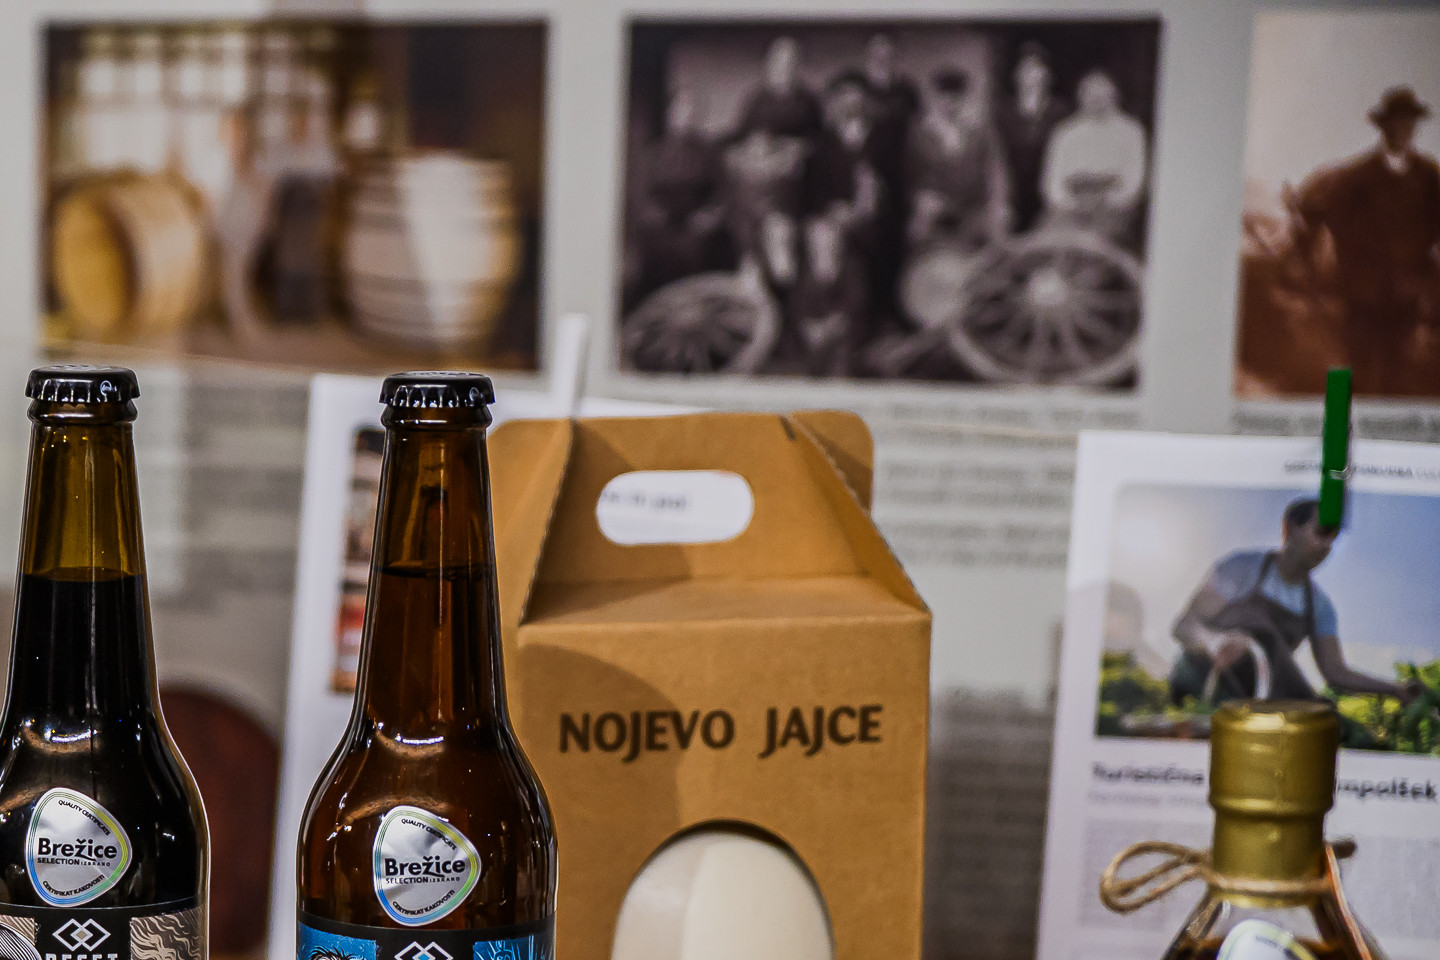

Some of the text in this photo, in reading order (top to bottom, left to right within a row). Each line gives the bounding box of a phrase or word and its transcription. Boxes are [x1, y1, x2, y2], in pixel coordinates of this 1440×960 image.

[559, 704, 883, 764] NOJEVO JAJCE
[38, 837, 118, 861] Brežice
[384, 855, 466, 877] Brežice
[385, 876, 428, 884] SELECTION
